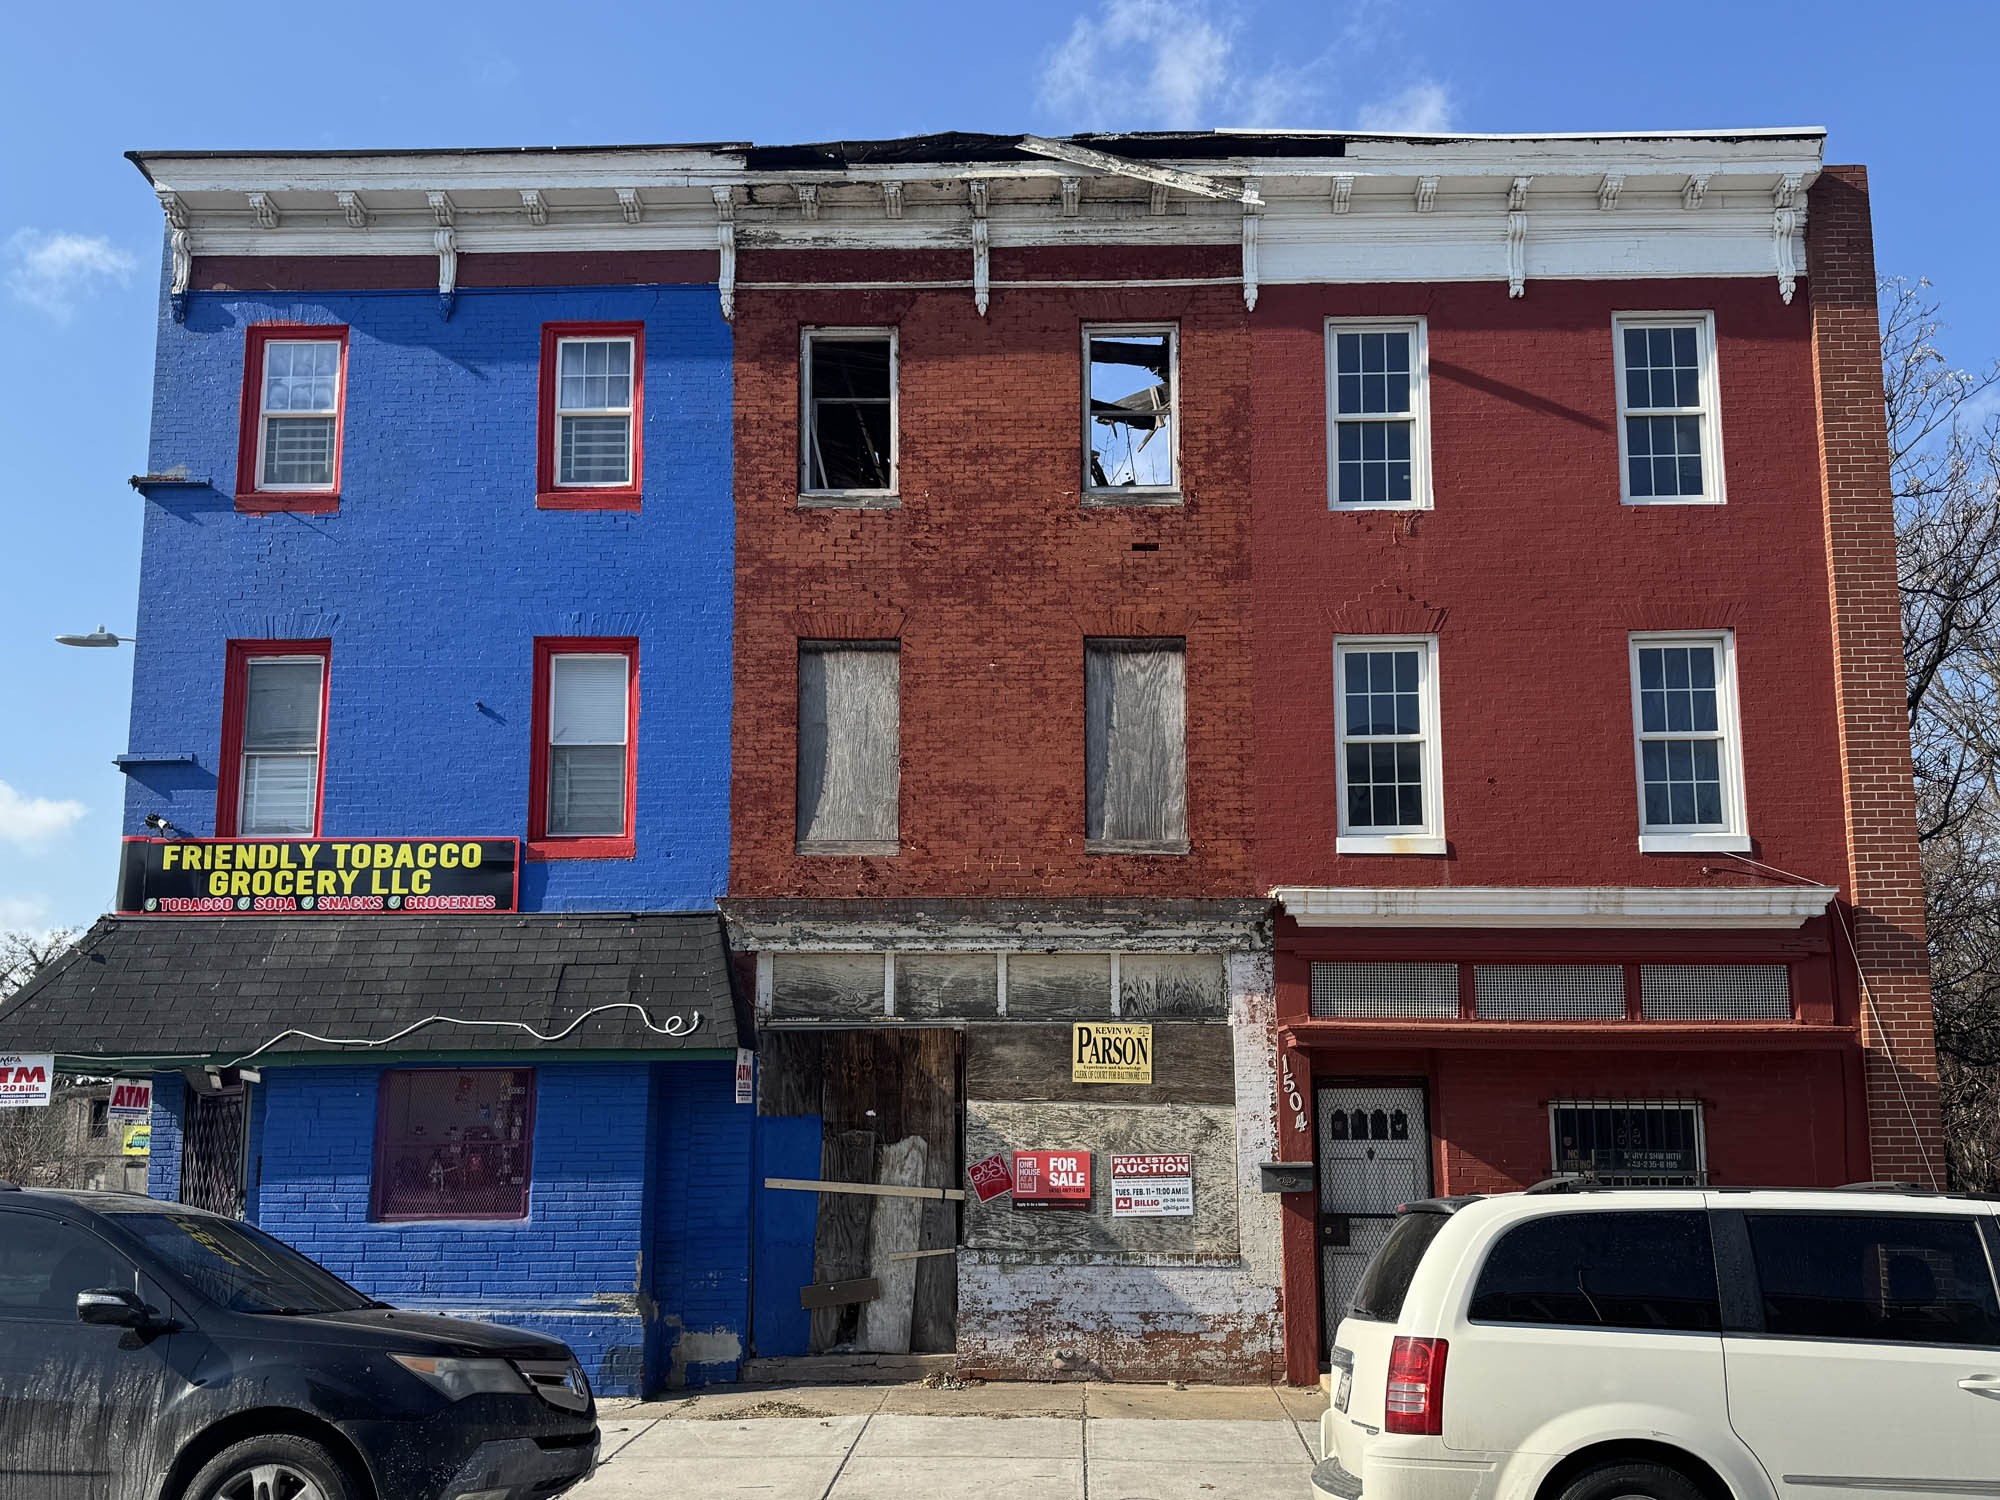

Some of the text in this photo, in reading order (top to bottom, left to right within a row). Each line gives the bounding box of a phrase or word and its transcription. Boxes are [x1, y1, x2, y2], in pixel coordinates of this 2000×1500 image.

[162, 843, 482, 871] FRIENDLY TOBACCO
[208, 869, 432, 896] GROCERY LLC
[160, 895, 496, 911] TOBACCO SODA SNACKS GROCERIES
[1095, 1027, 1135, 1035] KEVIN W.
[1077, 1026, 1148, 1065] PARSON
[0, 1066, 46, 1083] TM
[737, 1064, 752, 1081] ATM
[1074, 1070, 1087, 1079] CLERK
[112, 1085, 149, 1108] ATM
[1282, 1054, 1307, 1132] 1504
[1114, 1156, 1189, 1165] REAL ESTATE
[1567, 1149, 1579, 1159] NO
[1019, 1160, 1033, 1169] ONE
[1019, 1168, 1041, 1176] HOUSE
[1049, 1157, 1077, 1172] FOR
[1114, 1163, 1190, 1174] AUCTION
[1049, 1172, 1086, 1188] SALE
[1115, 1188, 1132, 1196] TUES.
[1132, 1188, 1145, 1196] FEB.
[1146, 1187, 1151, 1196] 11
[1156, 1187, 1171, 1195] 11:00
[1171, 1187, 1182, 1195] AM
[1117, 1199, 1131, 1208] AJ
[1134, 1199, 1161, 1208] BILLIG
